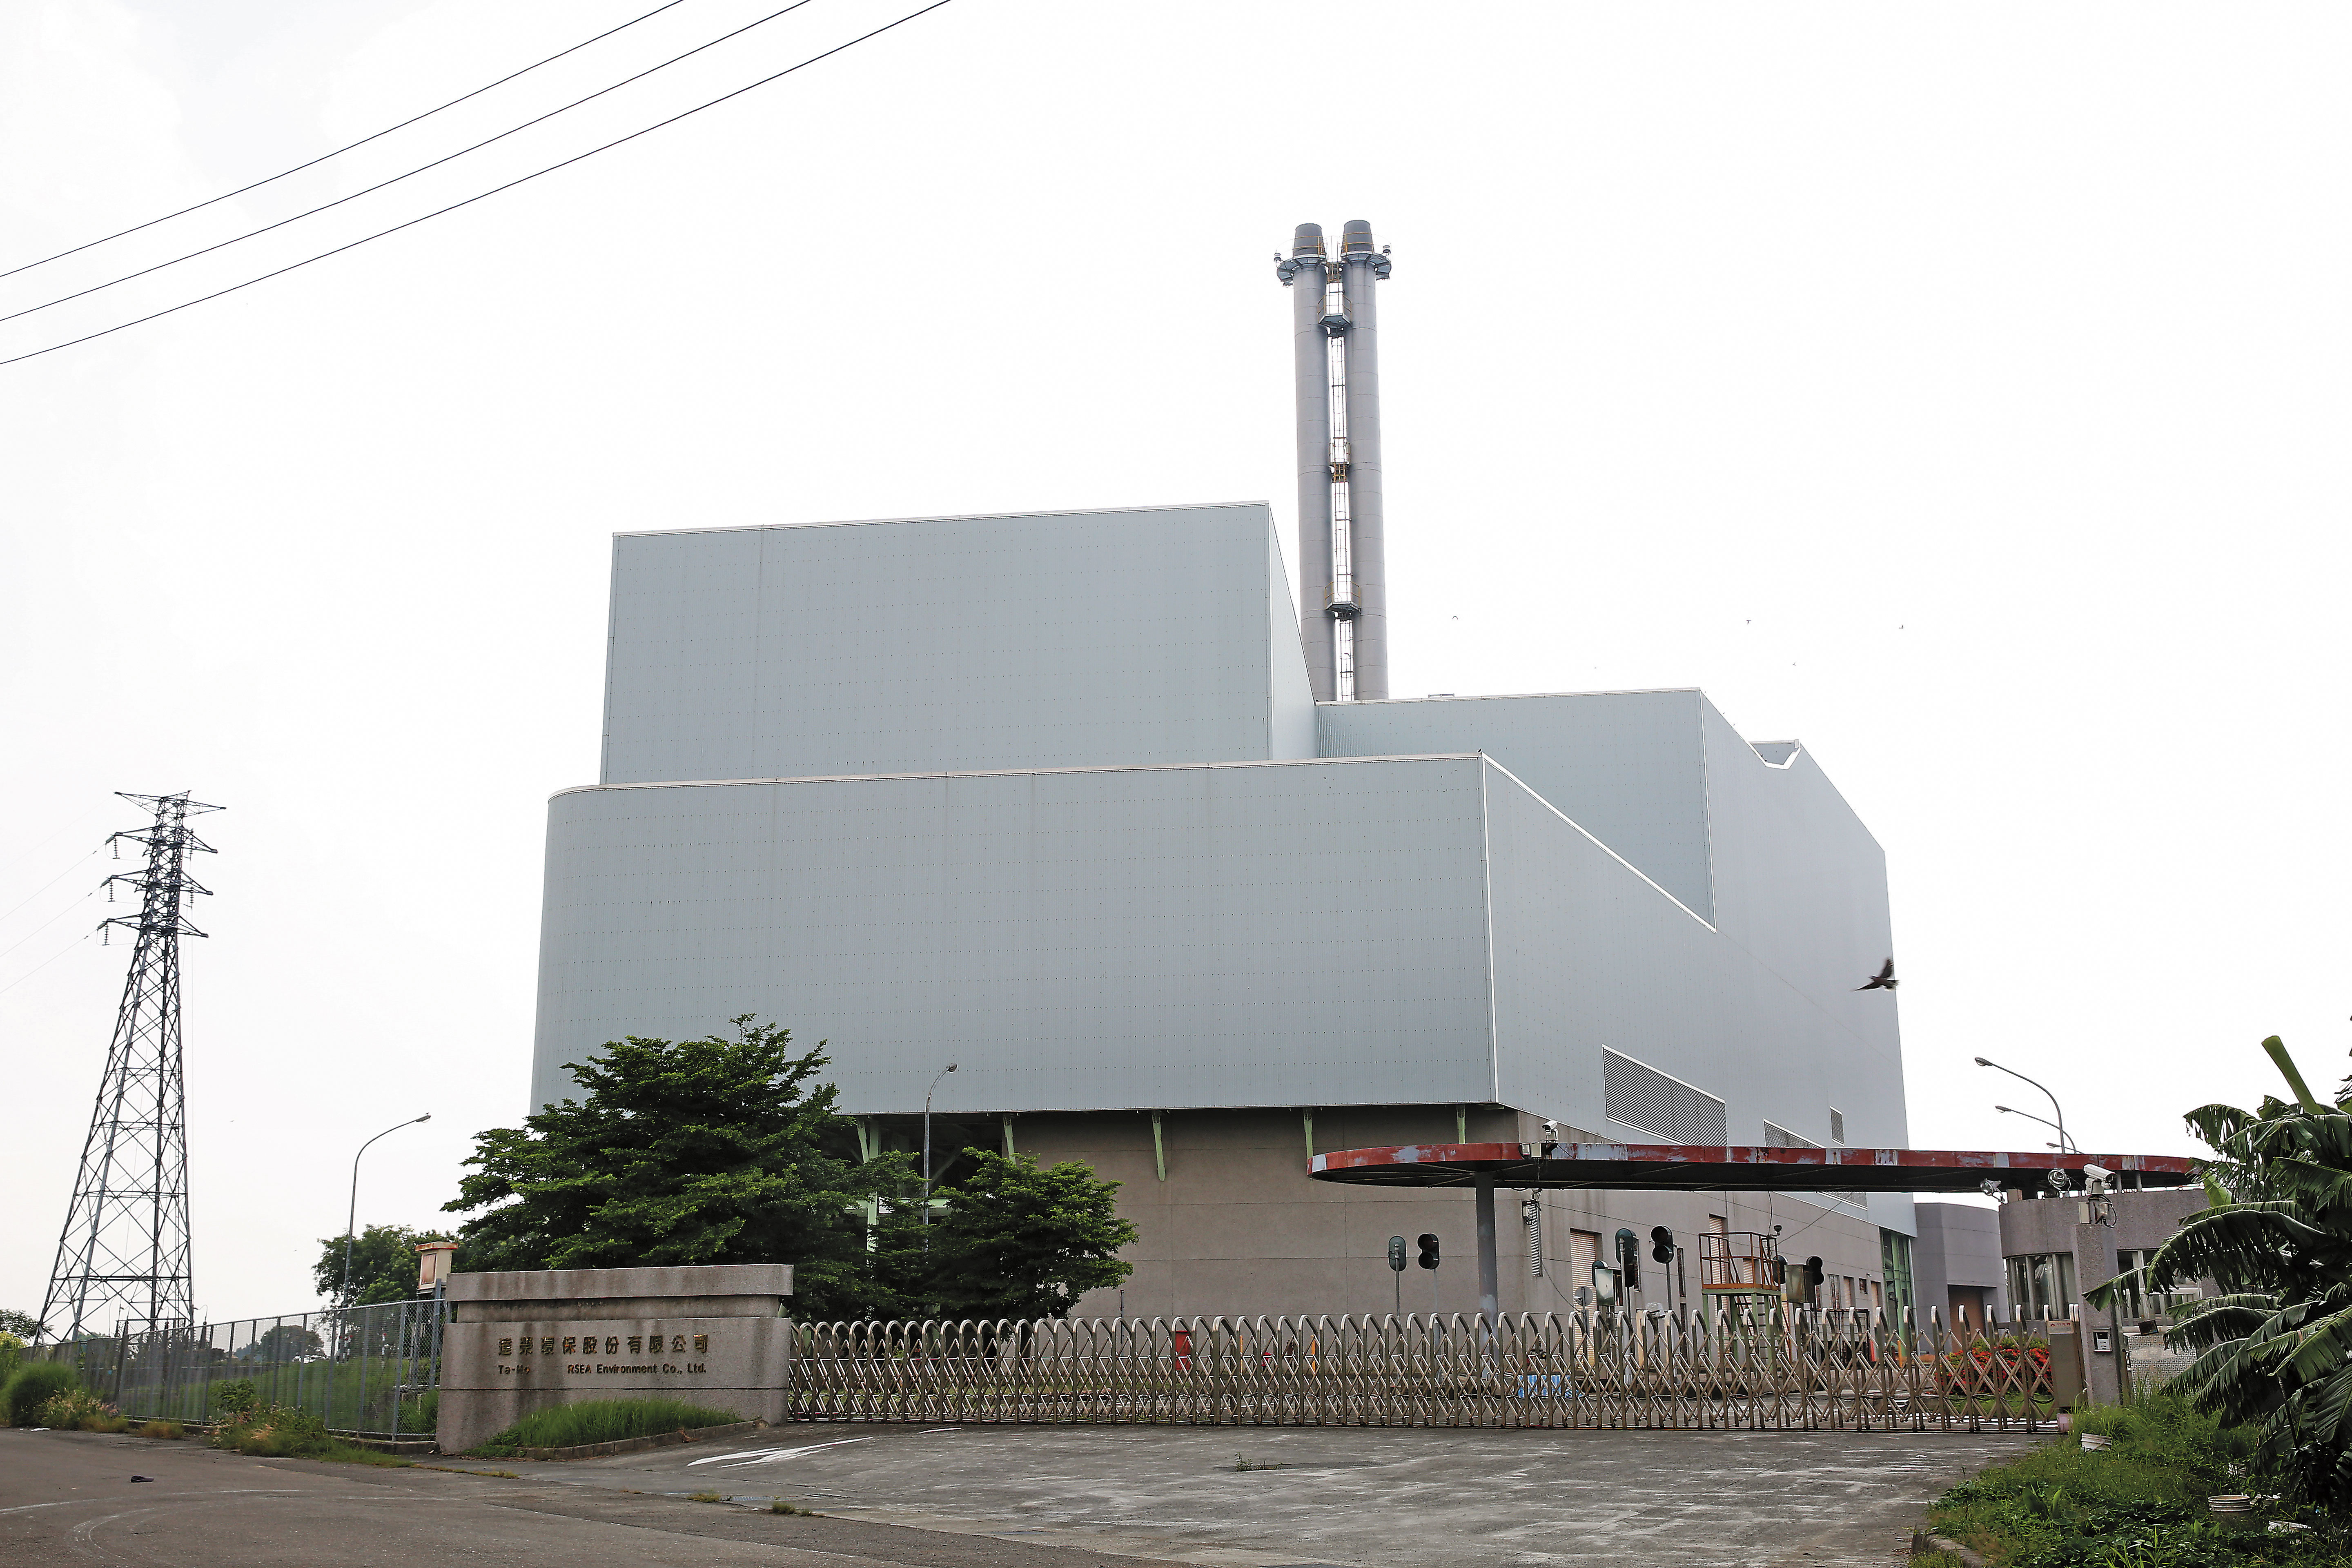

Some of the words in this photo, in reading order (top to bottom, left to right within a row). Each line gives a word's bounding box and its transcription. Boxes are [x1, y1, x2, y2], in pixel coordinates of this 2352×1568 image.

[568, 1364, 592, 1374] RSEA
[597, 1363, 657, 1374] Environment
[662, 1363, 682, 1374] Co.,
[687, 1362, 706, 1373] Ltd.
